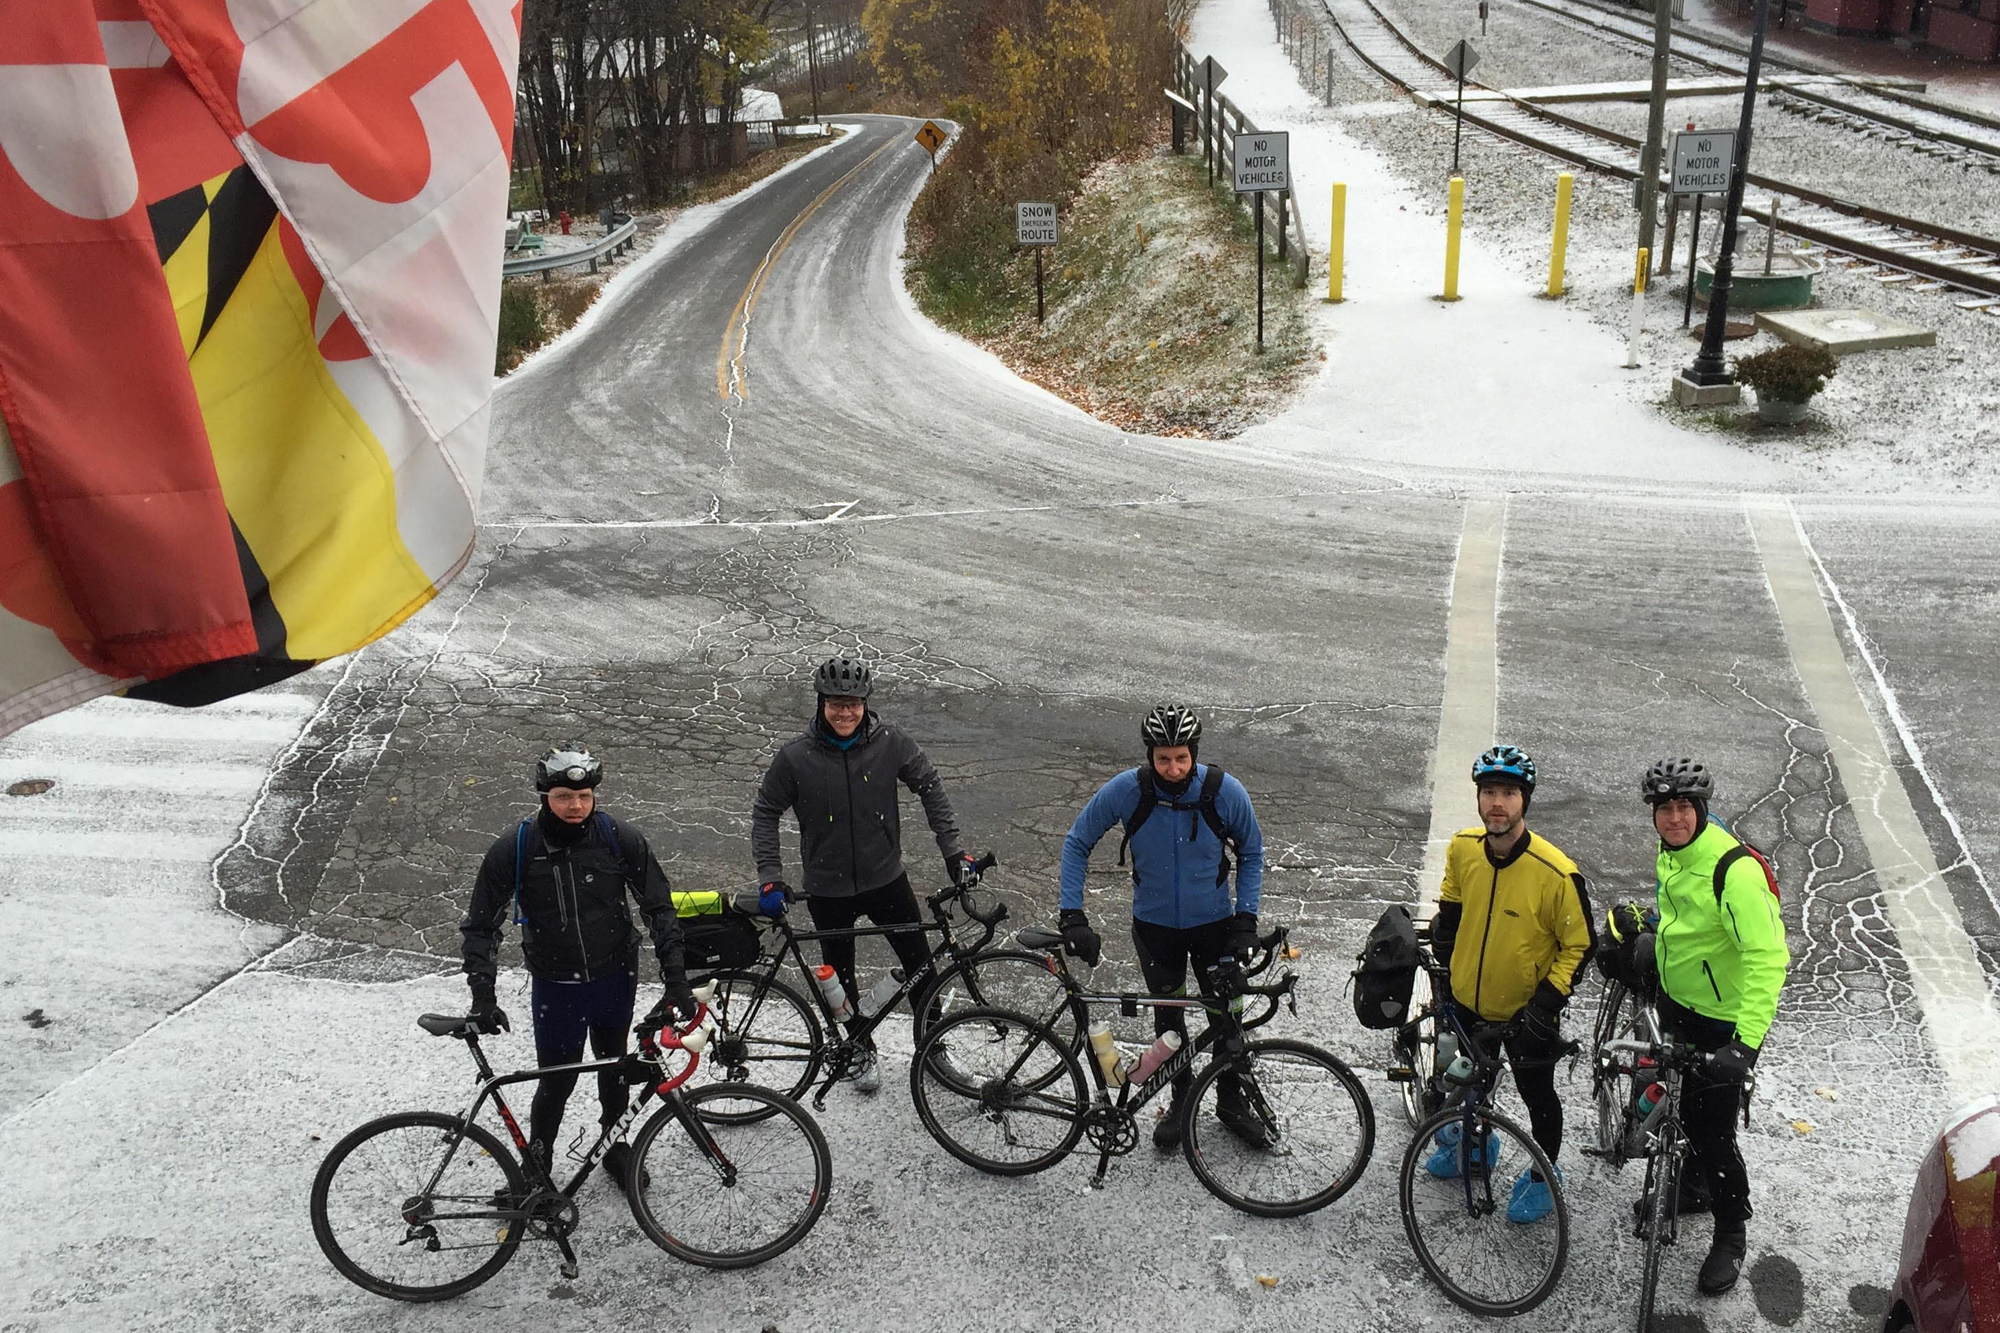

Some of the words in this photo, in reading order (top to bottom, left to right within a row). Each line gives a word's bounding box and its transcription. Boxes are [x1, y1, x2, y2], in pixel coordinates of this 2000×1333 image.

[1254, 140, 1268, 151] NO
[1697, 140, 1712, 152] NO
[1245, 156, 1276, 168] MOTOR
[1686, 157, 1720, 169] MOTOR
[1678, 173, 1726, 186] VEHICLES
[1022, 206, 1052, 217] SNOW
[1021, 229, 1055, 240] ROUTE
[902, 963, 930, 993] SURLY
[1135, 1040, 1197, 1107] SPECIALIZED
[590, 1094, 643, 1165] GIANT
